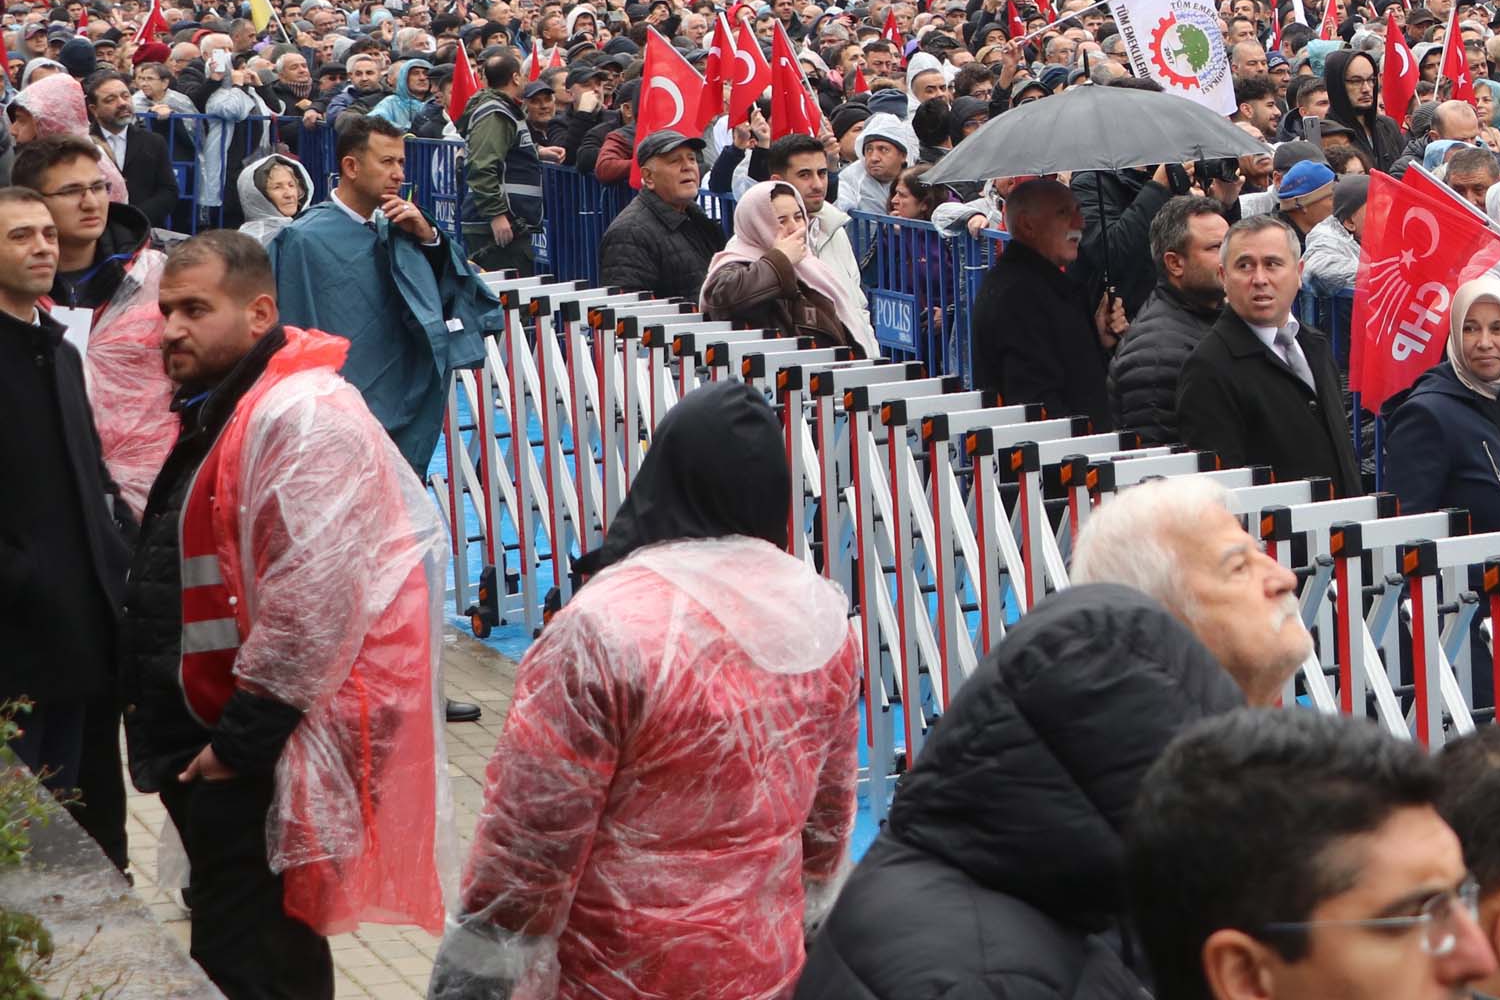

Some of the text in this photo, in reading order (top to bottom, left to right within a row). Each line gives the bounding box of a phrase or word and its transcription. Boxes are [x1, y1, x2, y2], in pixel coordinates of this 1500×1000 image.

[1115, 3, 1127, 26] TÜM
[1169, 0, 1191, 10] TÜM
[1163, 46, 1175, 65] 2017
[1391, 281, 1450, 361] CHP
